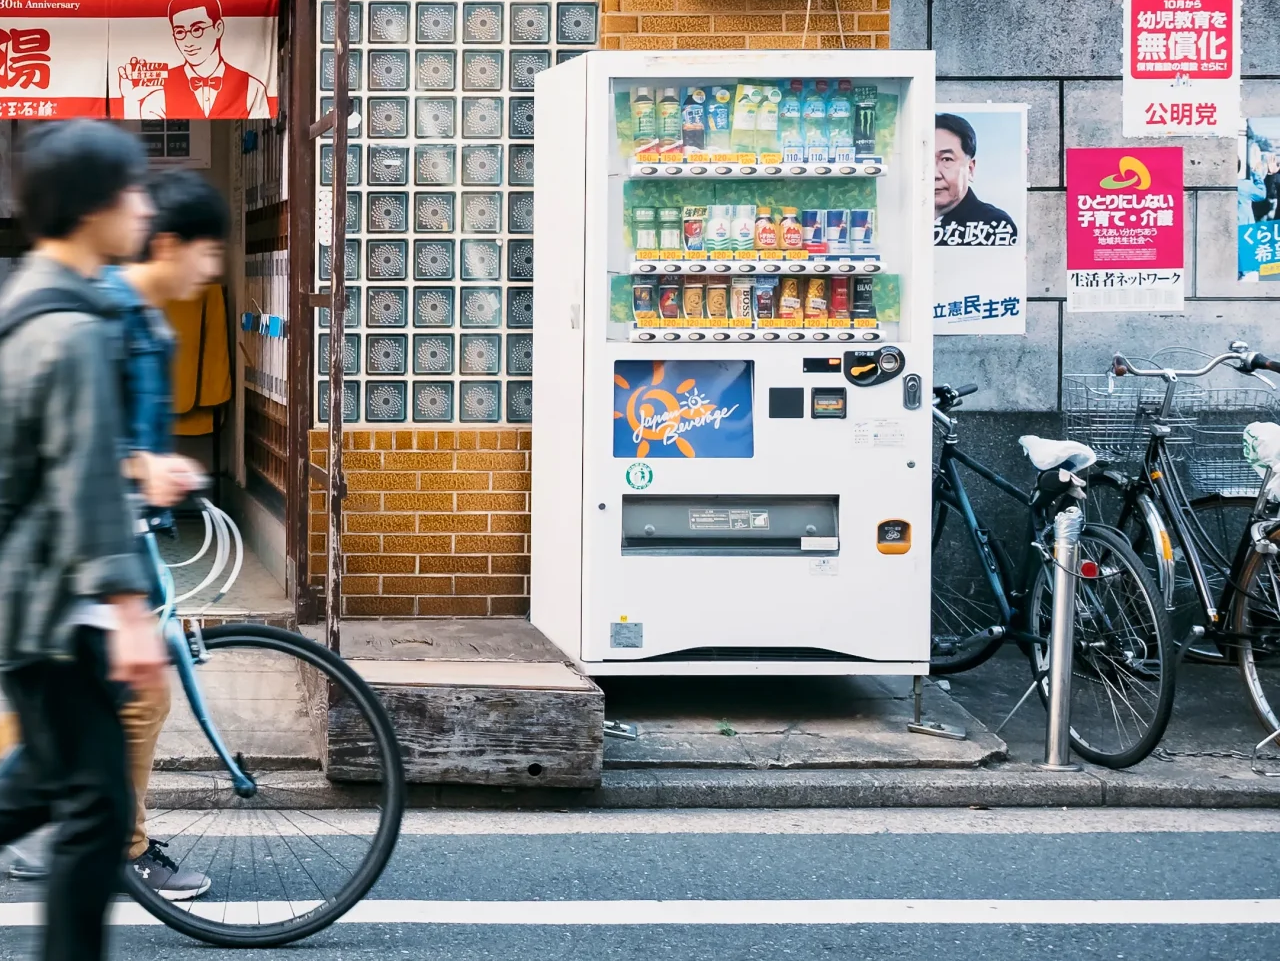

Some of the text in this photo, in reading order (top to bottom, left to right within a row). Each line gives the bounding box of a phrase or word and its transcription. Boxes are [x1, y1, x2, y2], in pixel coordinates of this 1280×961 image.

[25, 0, 81, 11] Anniversary
[1164, 0, 1202, 9] 10月から
[1137, 11, 1227, 29] 幼児教育を
[1136, 31, 1227, 60] 無償化
[1145, 102, 1218, 126] 公明党
[1078, 194, 1174, 210] ひとりにしない
[1078, 210, 1174, 227] 子育て・介護
[1255, 243, 1280, 262] 希
[1071, 272, 1181, 288] 生活者ネットワーク
[742, 290, 750, 317] BOSS
[933, 295, 1020, 319] 立憲民主党
[632, 406, 688, 443] Japan
[656, 404, 740, 446] Beverage
